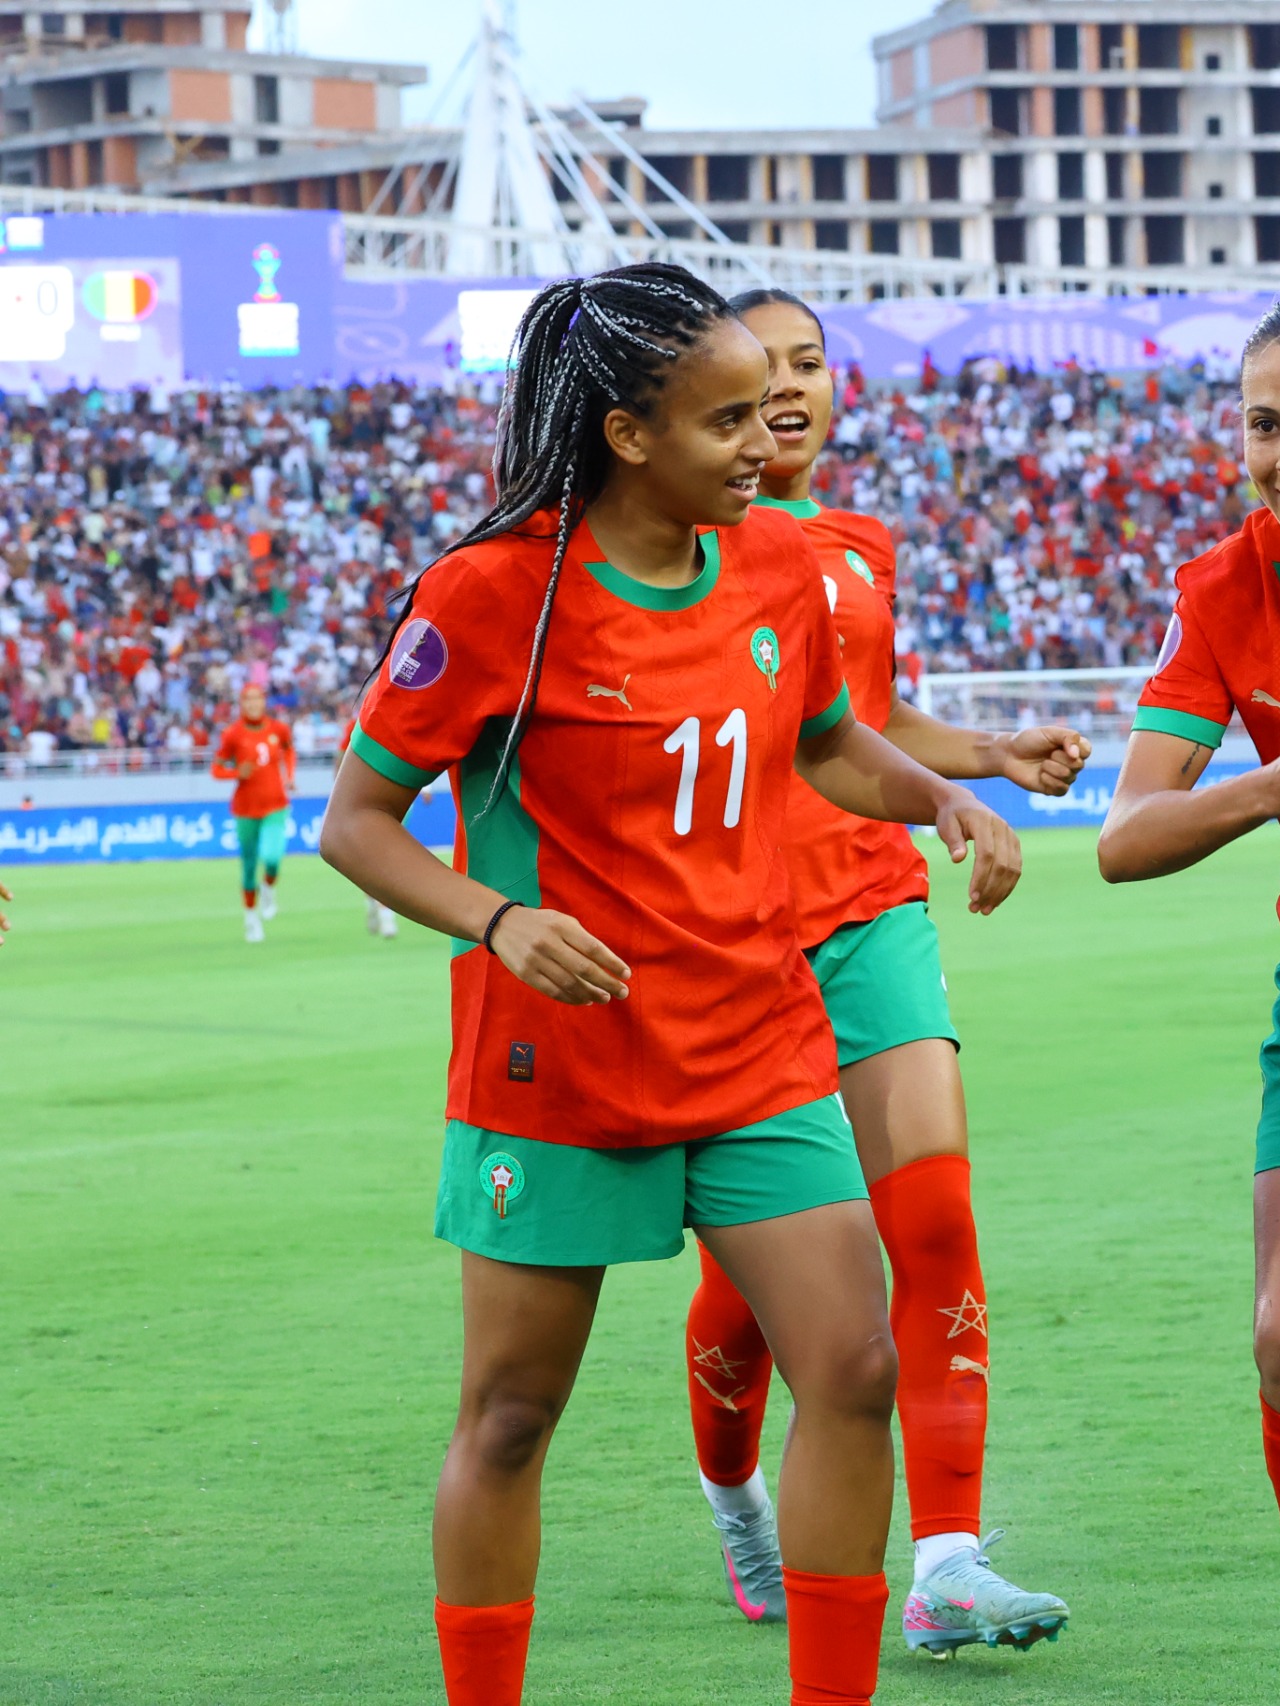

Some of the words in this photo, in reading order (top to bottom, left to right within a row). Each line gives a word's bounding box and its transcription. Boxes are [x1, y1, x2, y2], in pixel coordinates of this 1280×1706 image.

[663, 708, 748, 836] 11
[100, 814, 168, 857] القدم
[169, 811, 214, 848] كرة
